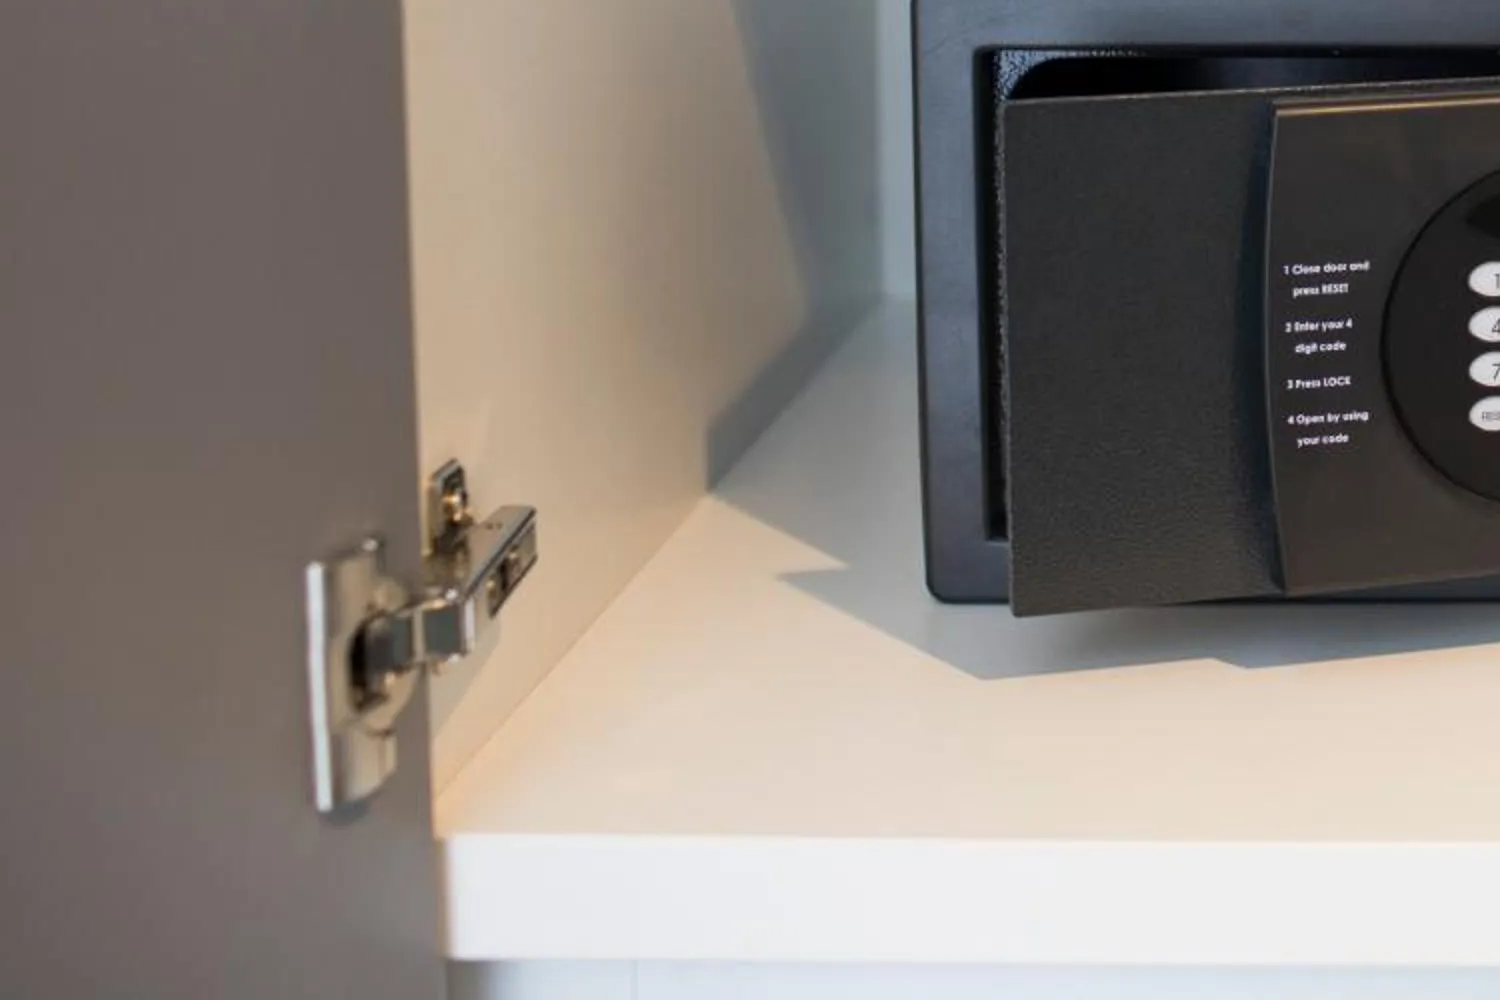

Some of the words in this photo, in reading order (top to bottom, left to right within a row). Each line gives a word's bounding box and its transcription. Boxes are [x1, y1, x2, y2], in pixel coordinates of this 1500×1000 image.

[1283, 265, 1289, 275] 1
[1291, 264, 1321, 276] Close
[1323, 262, 1347, 273] door
[1349, 260, 1370, 272] and
[1292, 286, 1320, 299] press
[1322, 283, 1349, 295] RESET
[1285, 322, 1292, 333] 2
[1294, 321, 1319, 332] Enter
[1321, 319, 1345, 333] your
[1346, 318, 1353, 329] 4
[1295, 342, 1318, 355] digit
[1319, 340, 1347, 352] code
[1287, 379, 1294, 390] 3
[1295, 378, 1321, 389] Press
[1323, 375, 1351, 387] LOCK
[1287, 414, 1295, 425] 4
[1296, 413, 1325, 426] Open
[1327, 412, 1340, 424] by
[1342, 410, 1369, 423] using
[1297, 435, 1321, 449] your
[1322, 433, 1350, 445] code
